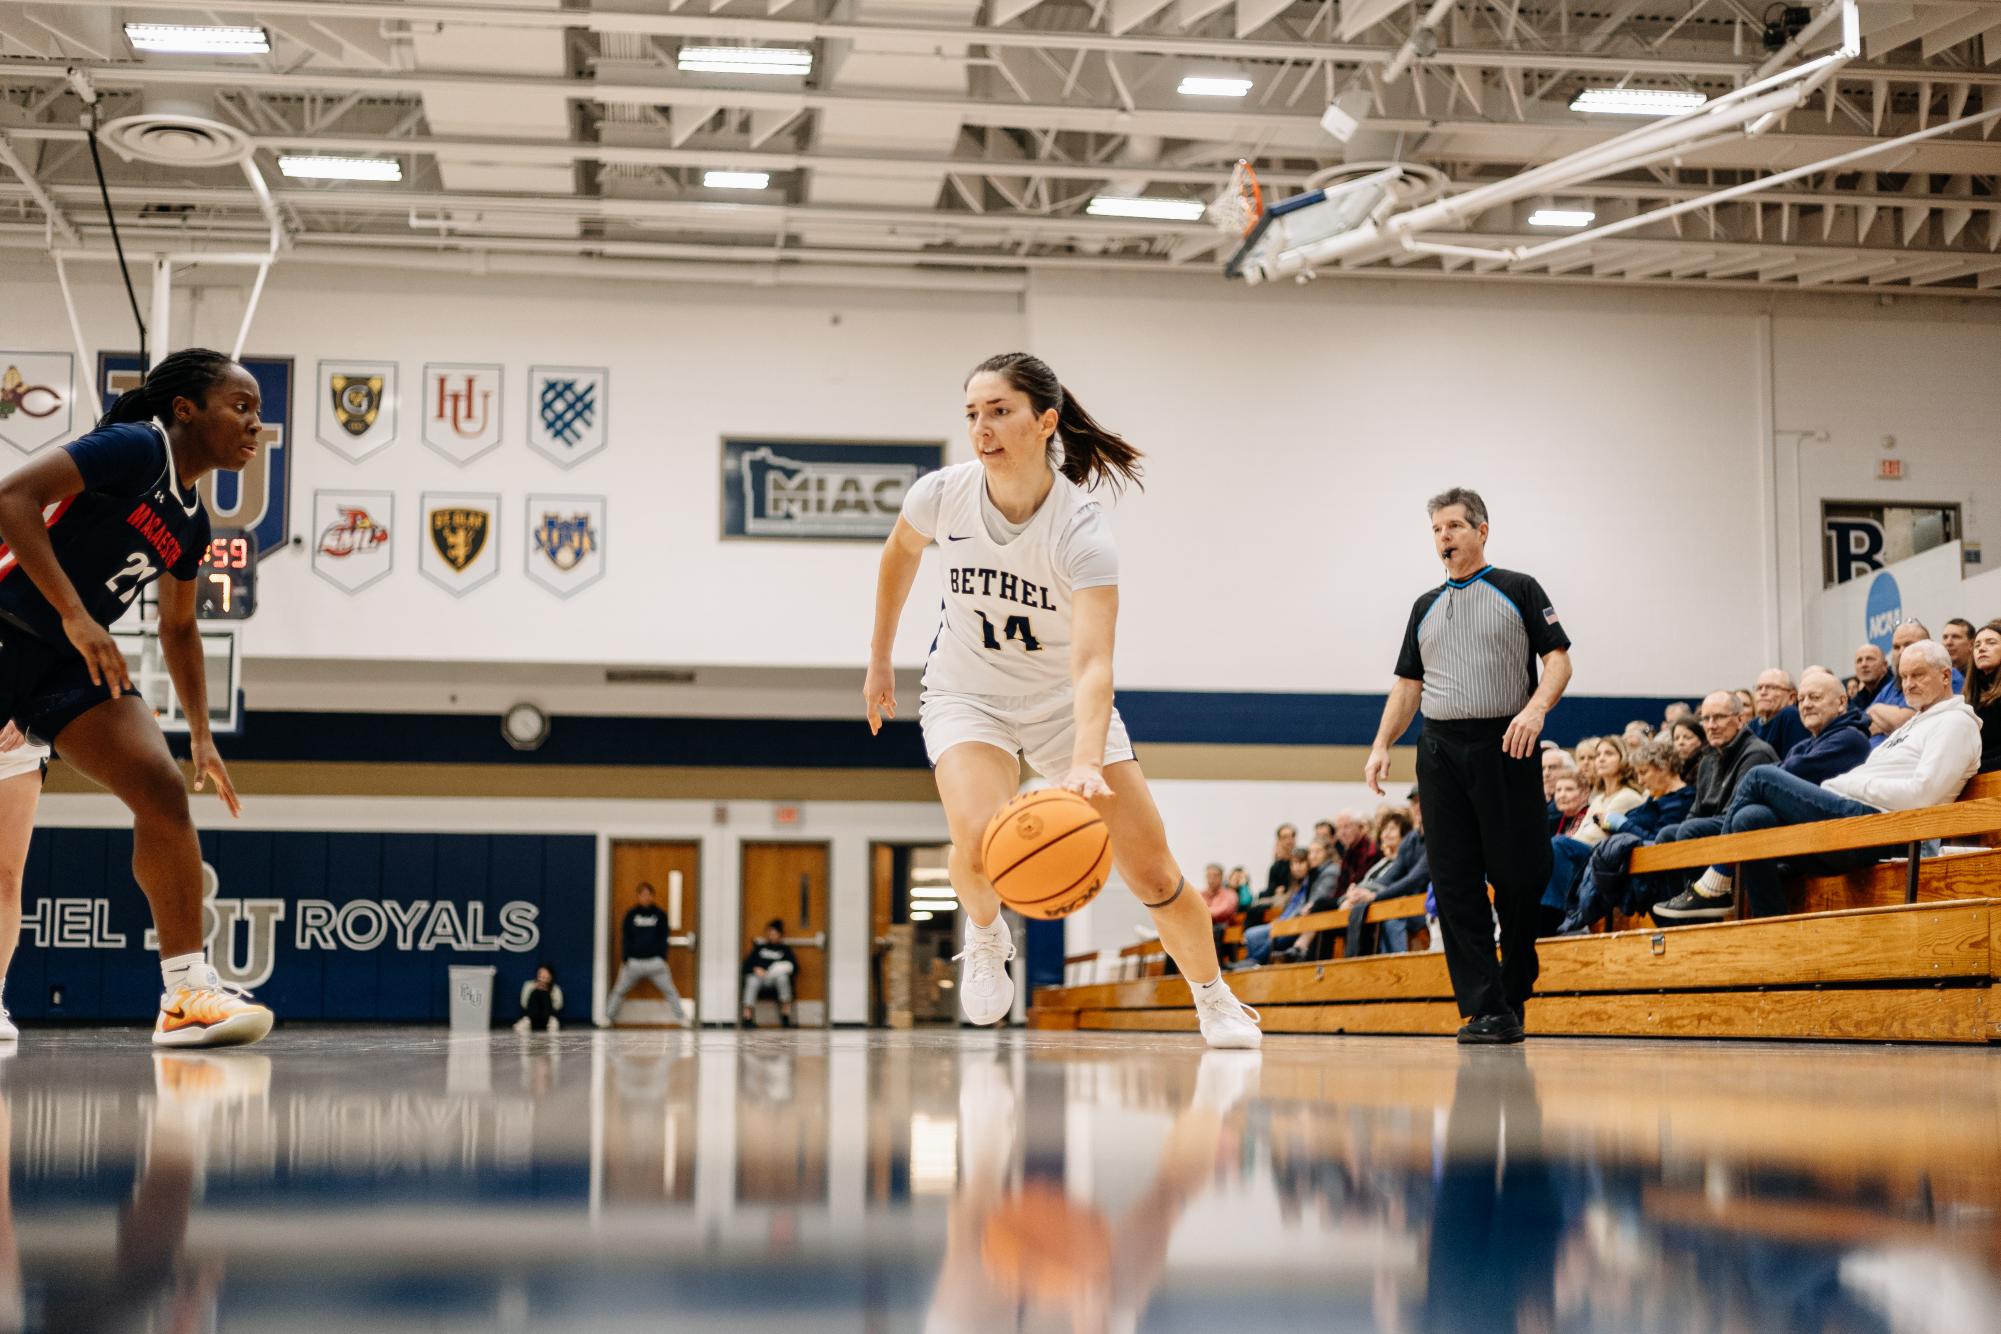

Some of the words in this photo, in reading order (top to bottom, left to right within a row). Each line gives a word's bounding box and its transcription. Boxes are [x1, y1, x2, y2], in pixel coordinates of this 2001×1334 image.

[434, 374, 493, 439] HU
[772, 478, 903, 513] MIAC
[1826, 516, 1884, 584] B
[208, 573, 231, 613] 7
[950, 567, 1056, 611] BETHEL
[974, 609, 1042, 651] 14
[295, 899, 540, 952] ROYALS
